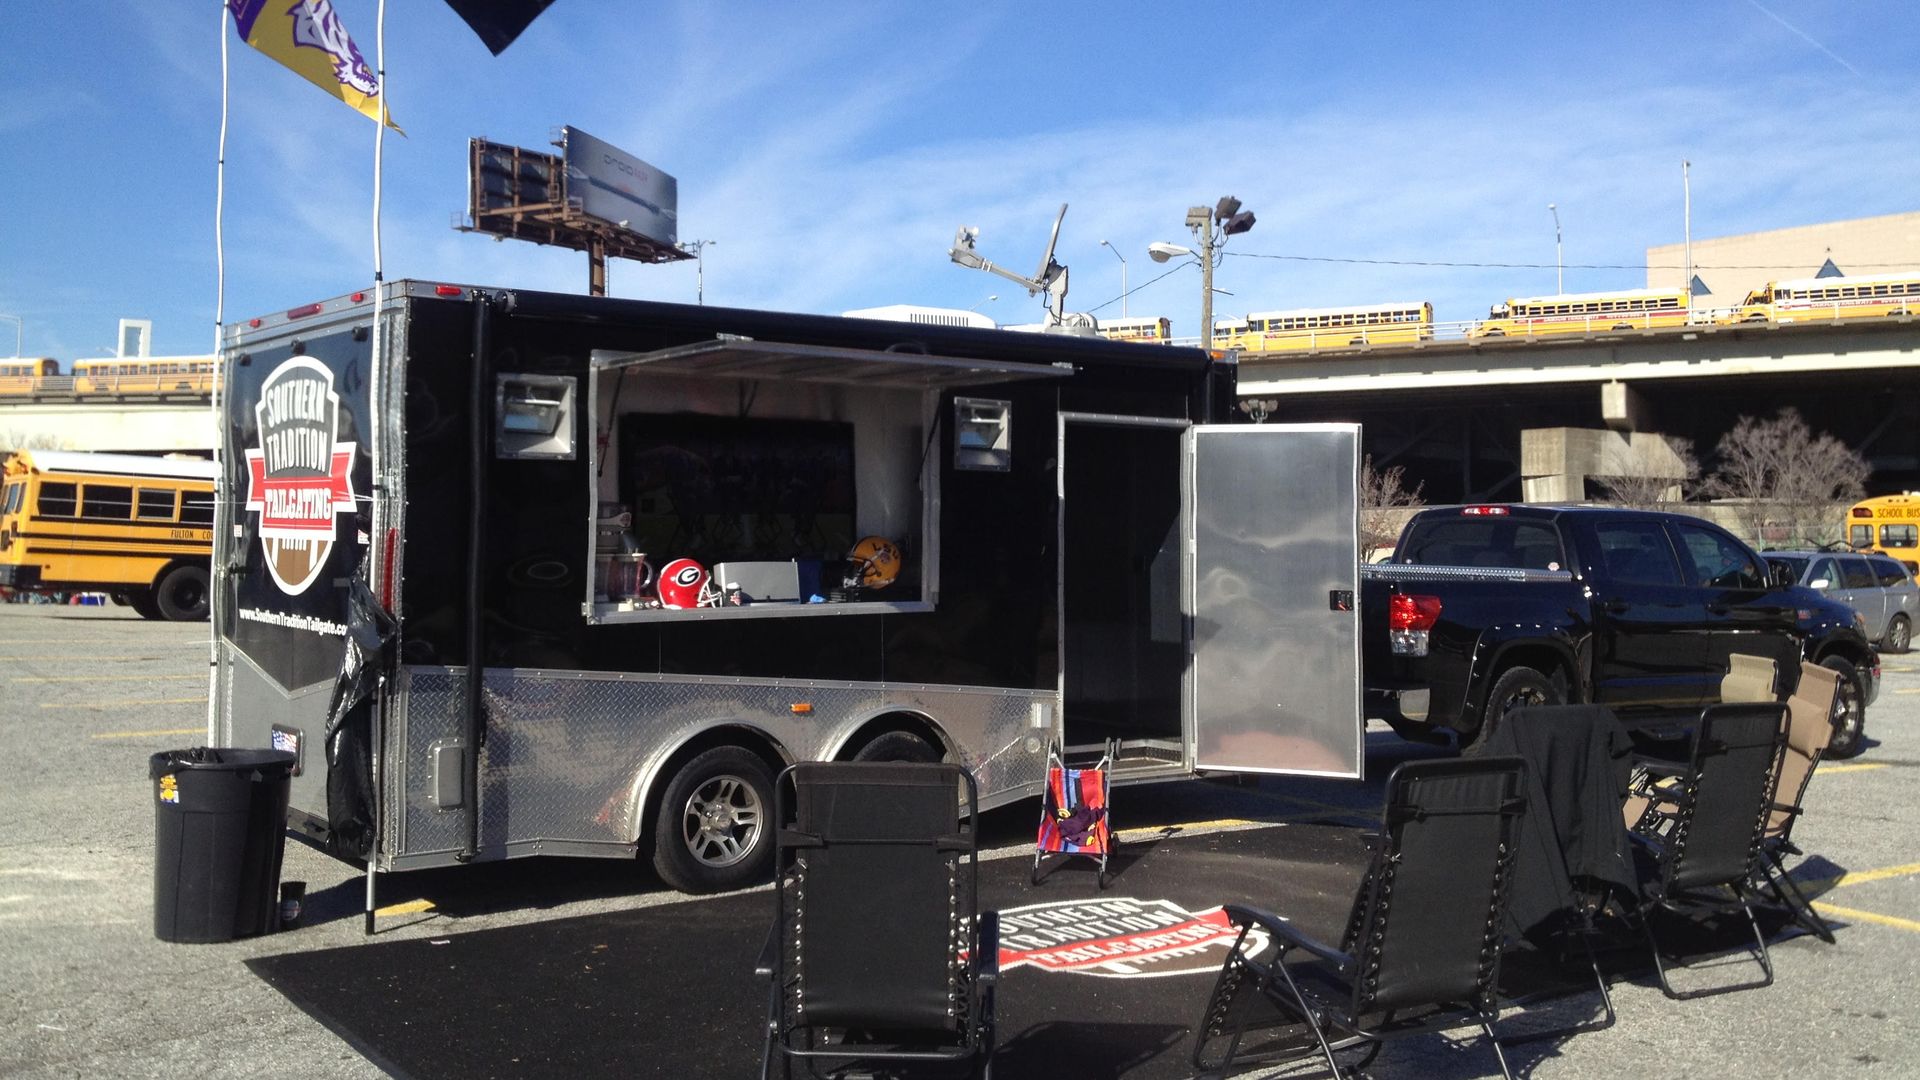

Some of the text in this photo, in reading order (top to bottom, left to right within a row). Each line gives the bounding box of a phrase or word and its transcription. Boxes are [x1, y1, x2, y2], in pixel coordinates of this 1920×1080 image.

[266, 379, 326, 428] SOUTHERN
[266, 427, 328, 473] TRADITION
[264, 487, 332, 520] TAILGATING
[1878, 508, 1903, 518] SCHOOL
[171, 529, 194, 539] FULTON
[676, 567, 700, 586] G
[239, 607, 348, 636] www.SouthernTraditionTailgate.co
[999, 910, 1186, 951] TRADITION
